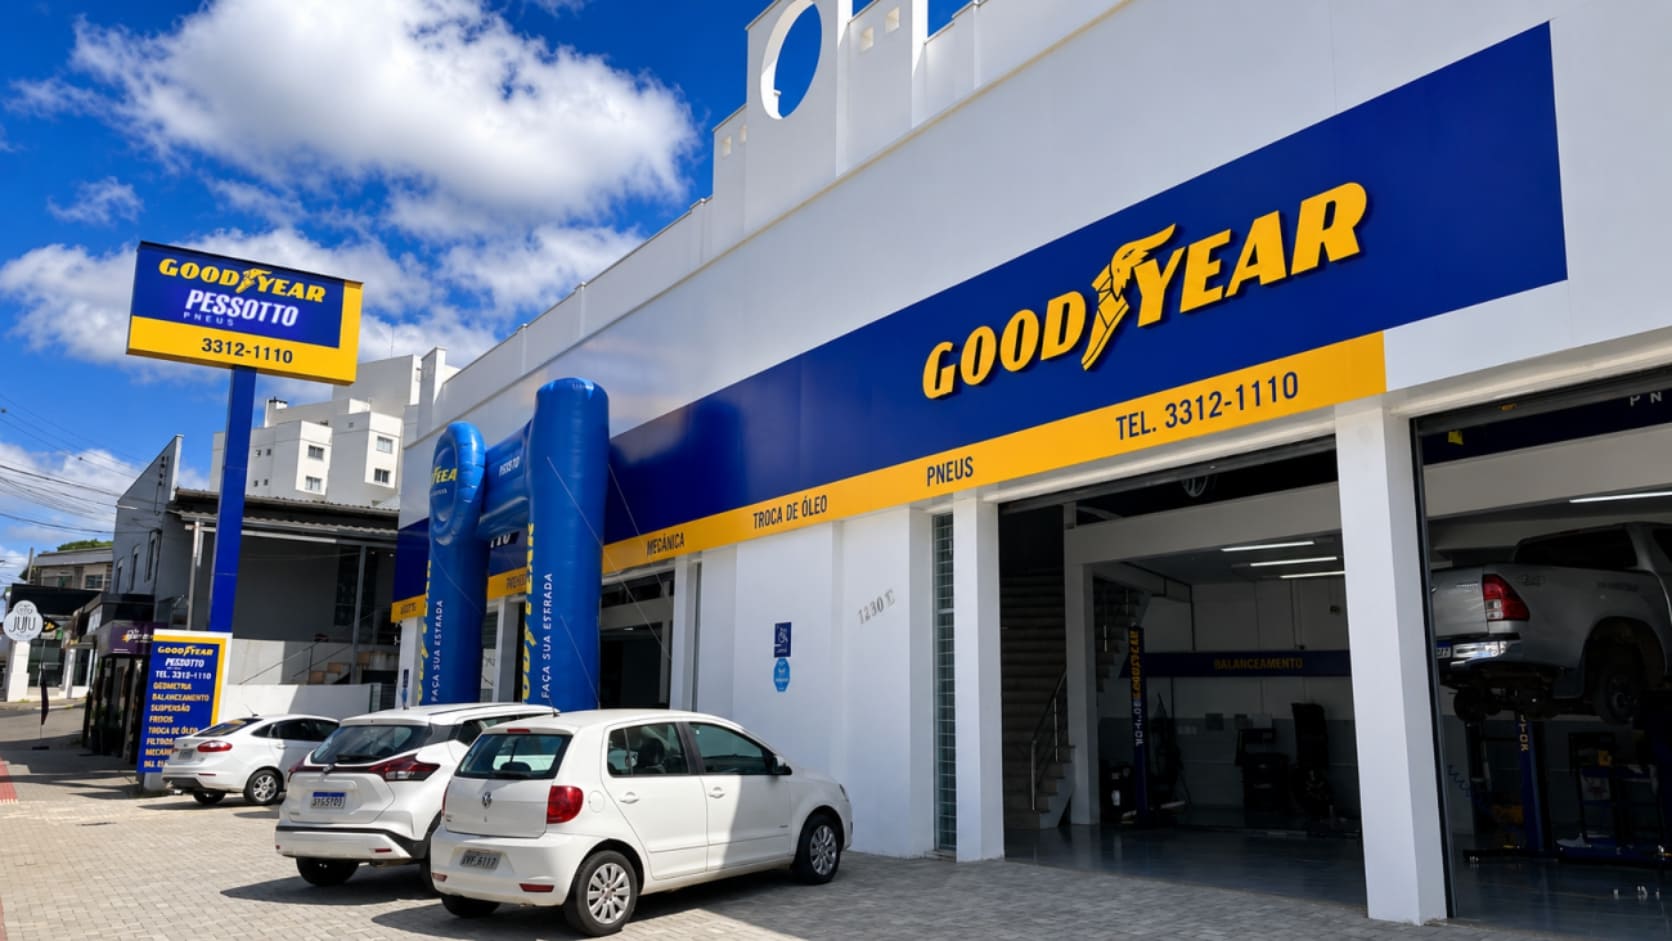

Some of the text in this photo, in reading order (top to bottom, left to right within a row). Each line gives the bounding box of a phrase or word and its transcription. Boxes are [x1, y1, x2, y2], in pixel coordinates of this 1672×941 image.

[183, 312, 235, 327] PNEUS
[185, 289, 299, 328] PESSOTTO
[201, 337, 294, 364] 3312-1110
[1116, 371, 1299, 441] TEL. 3312-1110
[926, 456, 974, 487] PNEUS
[753, 494, 828, 530] TROCA DE ÓLEO
[431, 600, 444, 702] FAÇA SUA ESTRADA
[542, 635, 552, 661] SUA
[1213, 656, 1304, 671] BALANCEAMENTO
[155, 670, 170, 679] TEL.
[541, 665, 552, 699] FAÇA
